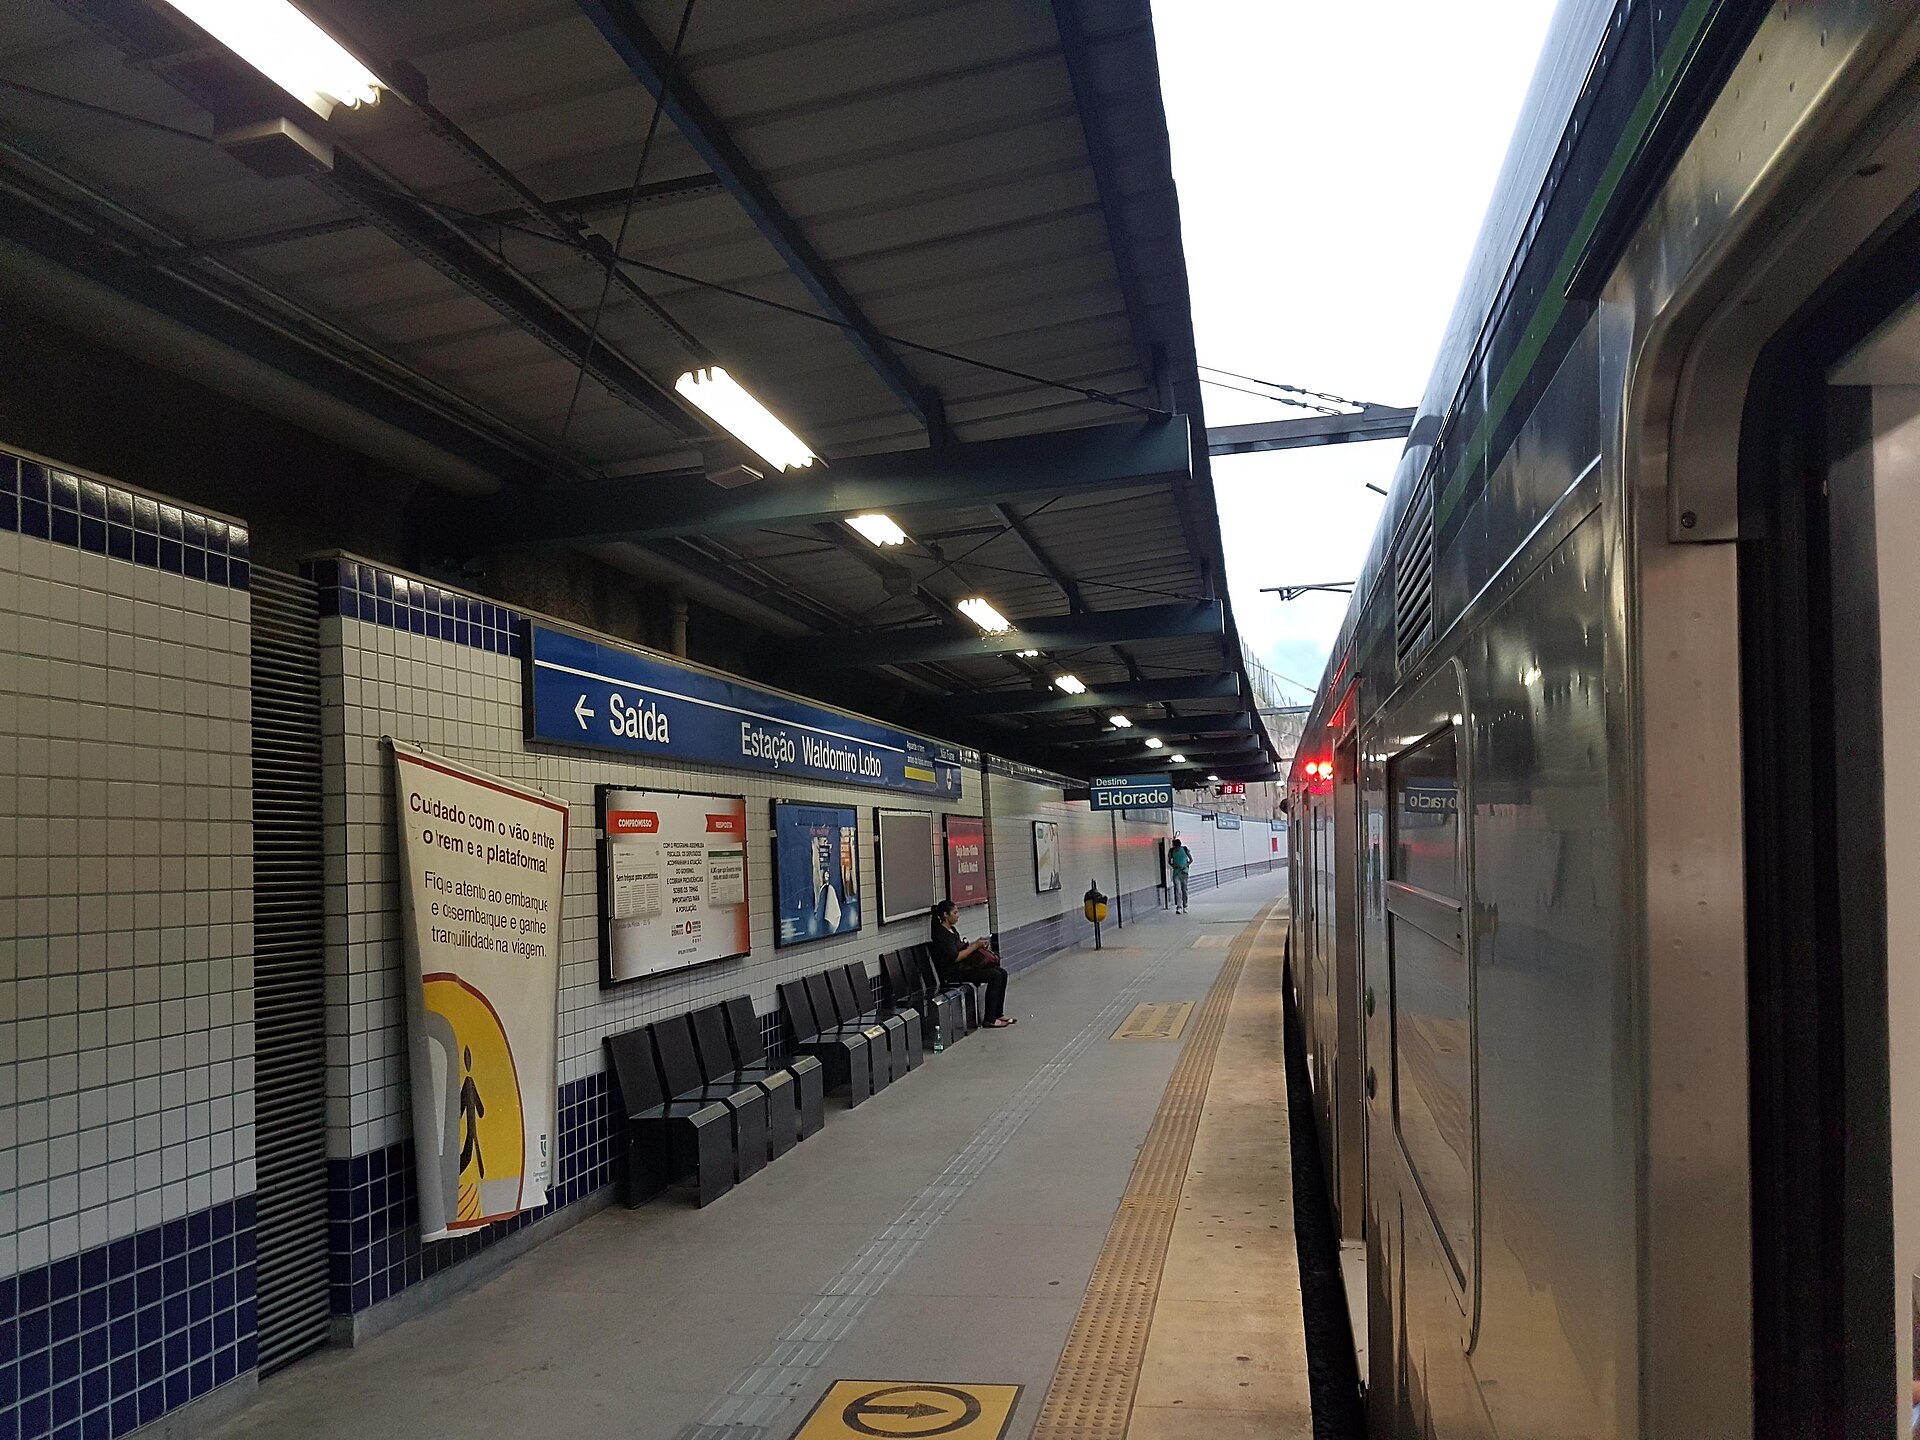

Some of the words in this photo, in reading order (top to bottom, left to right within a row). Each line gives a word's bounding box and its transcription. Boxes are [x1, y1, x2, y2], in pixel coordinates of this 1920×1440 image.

[608, 693, 670, 745] Saída
[741, 721, 796, 769] Estação
[801, 735, 858, 774] Waldomiro
[858, 751, 882, 778] Lobo
[1096, 778, 1128, 787] Destino
[1098, 789, 1169, 807] Eldorado
[410, 792, 466, 825] Cuidado
[468, 813, 495, 834] com
[498, 822, 506, 836] o
[509, 822, 530, 842] vão
[532, 831, 555, 850] entre
[422, 829, 434, 845] o
[435, 829, 464, 853] trem
[467, 841, 474, 856] e
[476, 843, 483, 859] a
[486, 844, 548, 874] plataforma!
[424, 870, 453, 895] Fiqe
[455, 880, 487, 900] atento
[488, 888, 502, 904] ao
[504, 891, 549, 915] embarque
[431, 901, 439, 916] e
[510, 916, 517, 930] e
[519, 917, 547, 935] ganhe
[495, 938, 509, 953] na
[511, 938, 547, 960] viagem.
